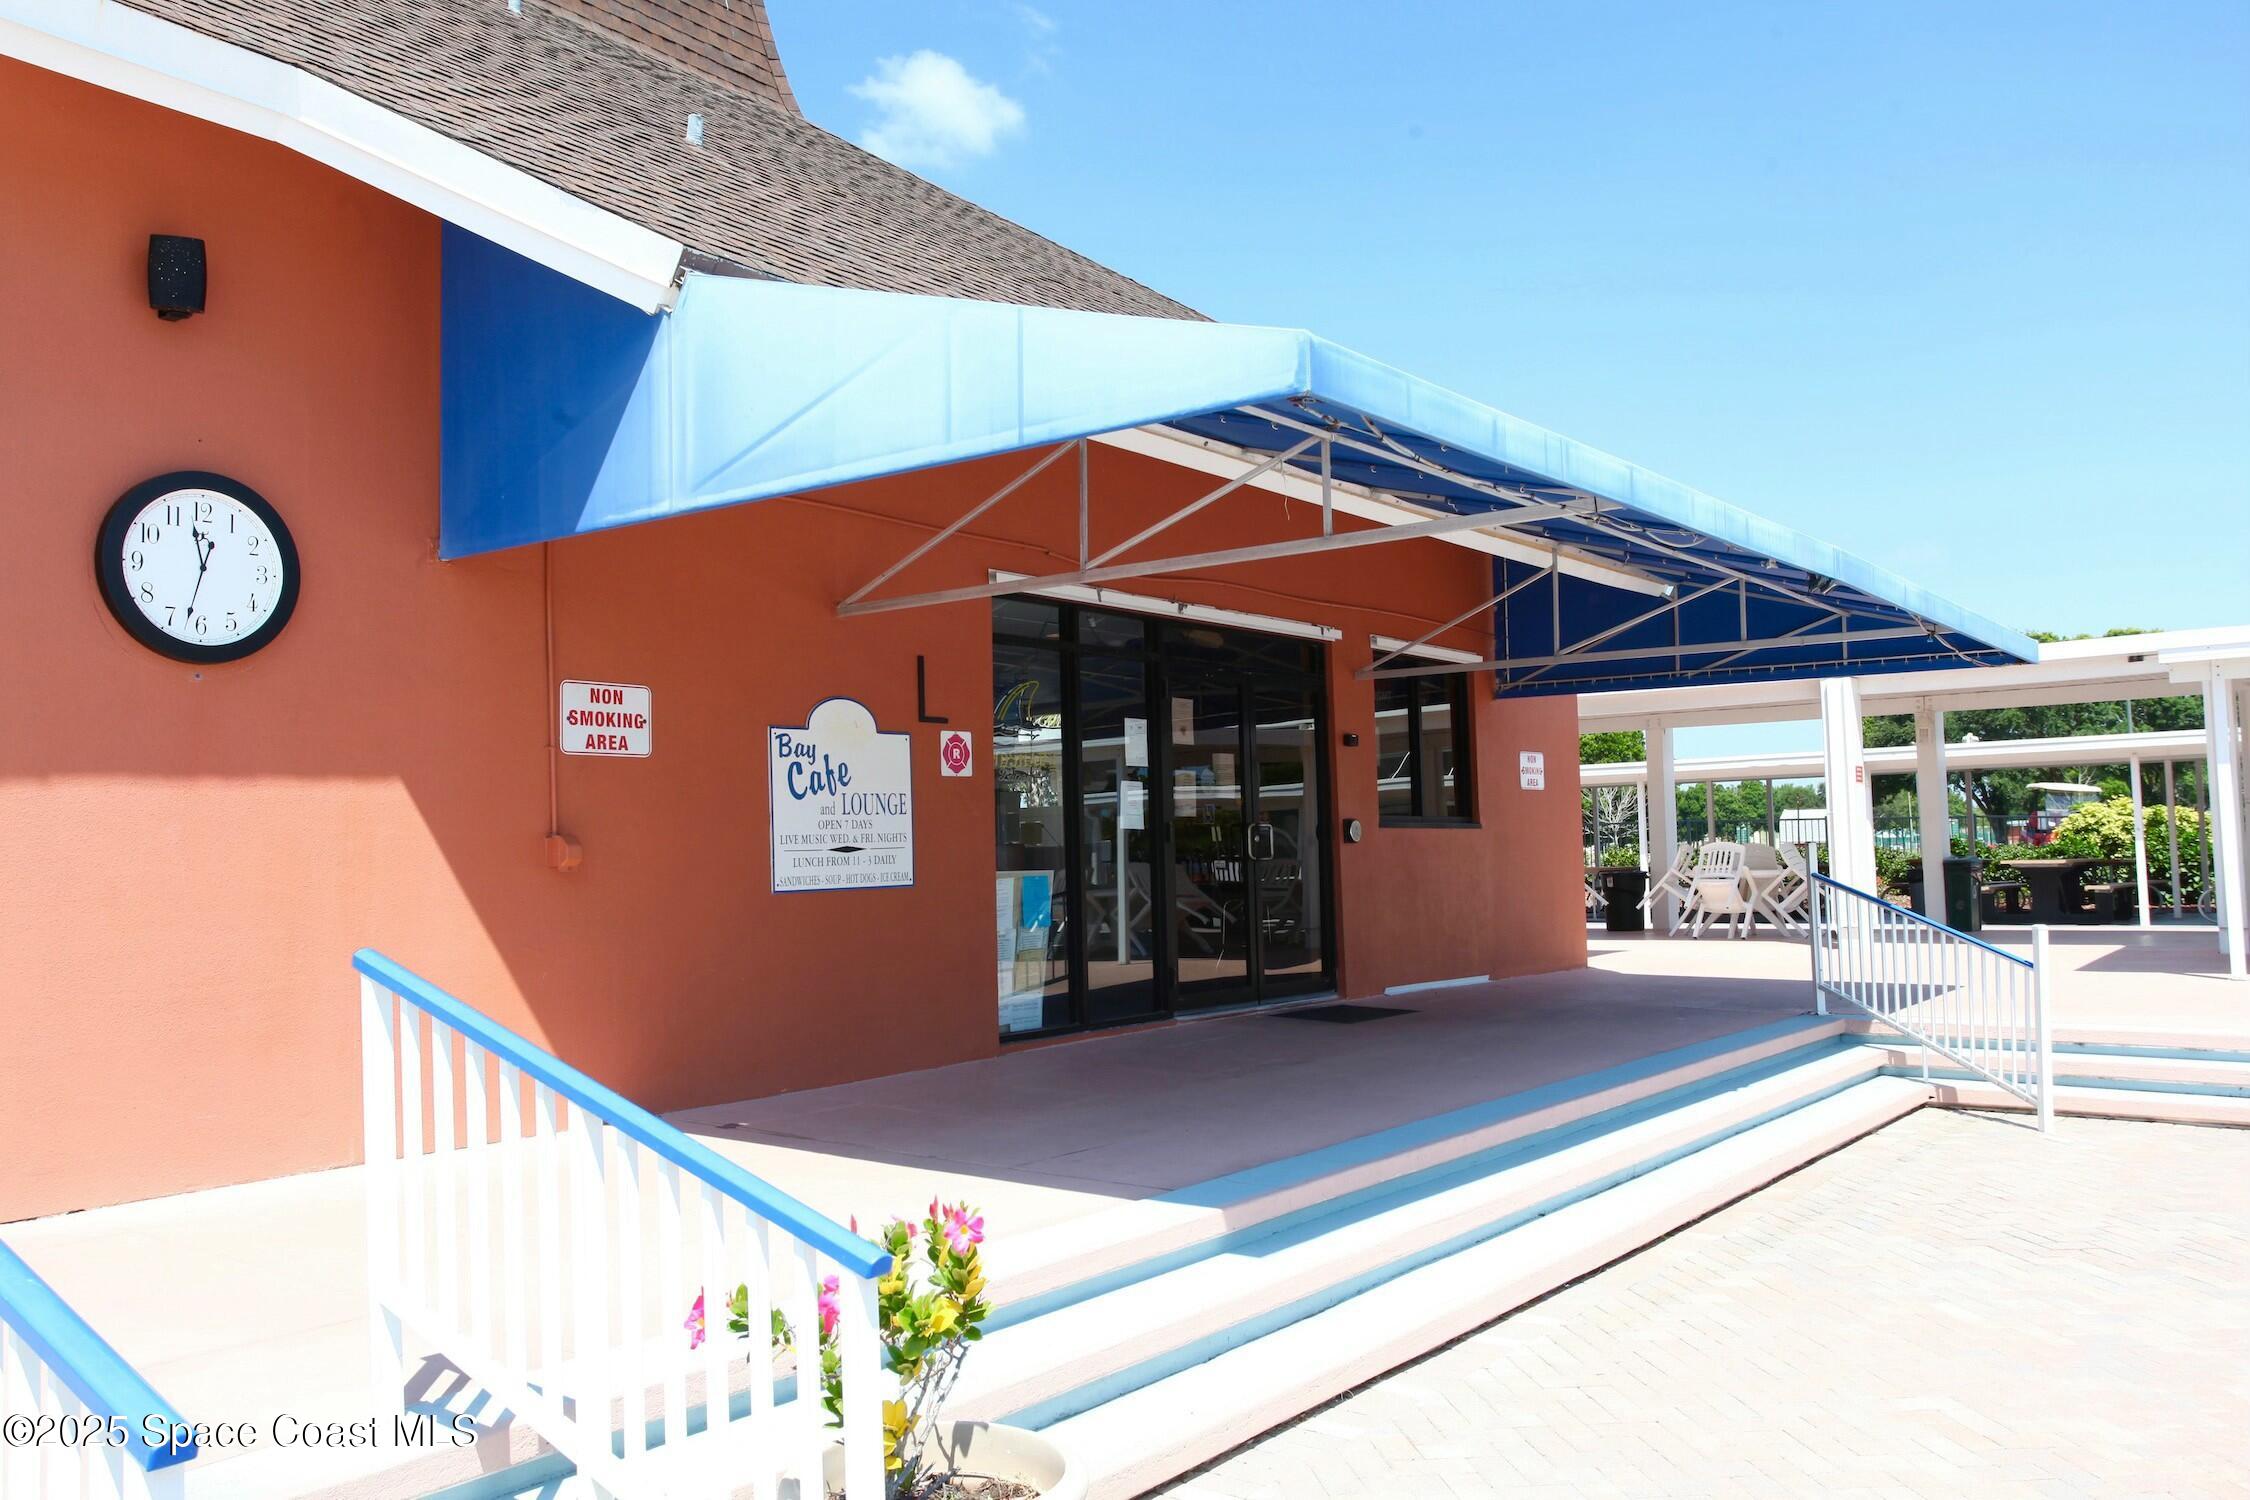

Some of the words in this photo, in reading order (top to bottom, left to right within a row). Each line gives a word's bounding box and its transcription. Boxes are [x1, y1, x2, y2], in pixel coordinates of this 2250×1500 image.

[167, 505, 180, 527] 11
[194, 502, 213, 523] 12
[141, 522, 160, 545] 10
[247, 536, 259, 556] 2
[131, 550, 144, 571] 9
[256, 565, 268, 585] 3
[140, 582, 154, 603] 8
[247, 593, 258, 612] 4
[165, 606, 176, 627] 7
[195, 615, 207, 635] 6
[226, 612, 237, 632] 5
[590, 688, 623, 705] NON
[568, 709, 644, 729] SMOKING
[585, 734, 628, 751] AREA
[775, 733, 816, 765] Bay
[953, 748, 960, 759] R
[787, 753, 852, 801] Cafe
[820, 801, 836, 816] and
[841, 792, 908, 816] LOUNGE
[818, 820, 842, 830] OPEN
[851, 820, 873, 829] DAYS
[780, 834, 799, 845] LIVE
[801, 834, 829, 845] MUSIC
[830, 833, 850, 844] WED.
[851, 835, 858, 843] &
[861, 833, 875, 843] FRI.
[876, 833, 908, 843] NIGHTS
[793, 857, 824, 868] LUNCH
[827, 856, 850, 867] FROM
[853, 856, 860, 866] 11
[874, 855, 897, 865] DAILY
[780, 876, 820, 887] SANDWICHES
[825, 875, 841, 885] SOUP
[846, 874, 860, 884] HOT
[860, 873, 876, 883] DOGS
[890, 872, 909, 882] CREAM
